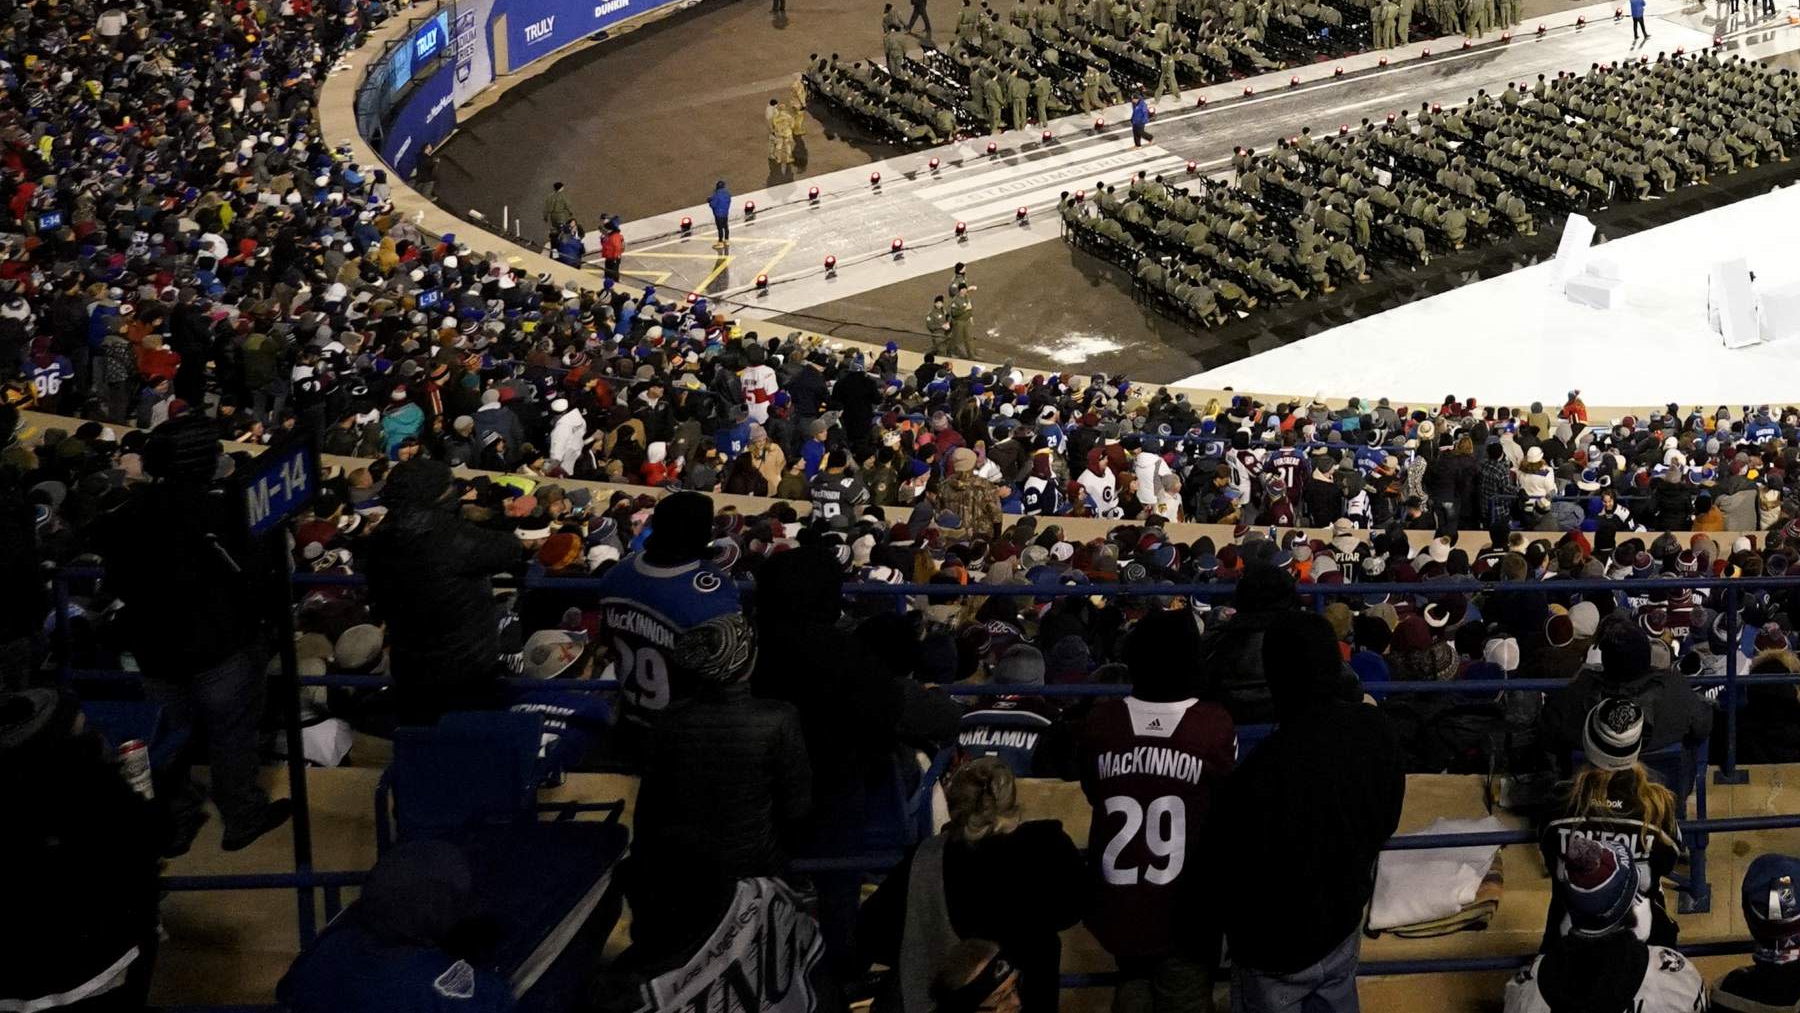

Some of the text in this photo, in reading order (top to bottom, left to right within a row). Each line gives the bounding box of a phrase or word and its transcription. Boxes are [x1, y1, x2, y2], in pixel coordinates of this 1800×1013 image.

[416, 28, 438, 55] TRULY
[525, 15, 554, 42] TRULY
[418, 291, 438, 307] L-13
[34, 375, 61, 396] 96
[247, 451, 306, 530] M-14
[1335, 552, 1359, 563] PITAR
[606, 607, 675, 650] MacKINNON
[1097, 745, 1203, 786] MacKINNON
[1102, 795, 1187, 886] 29
